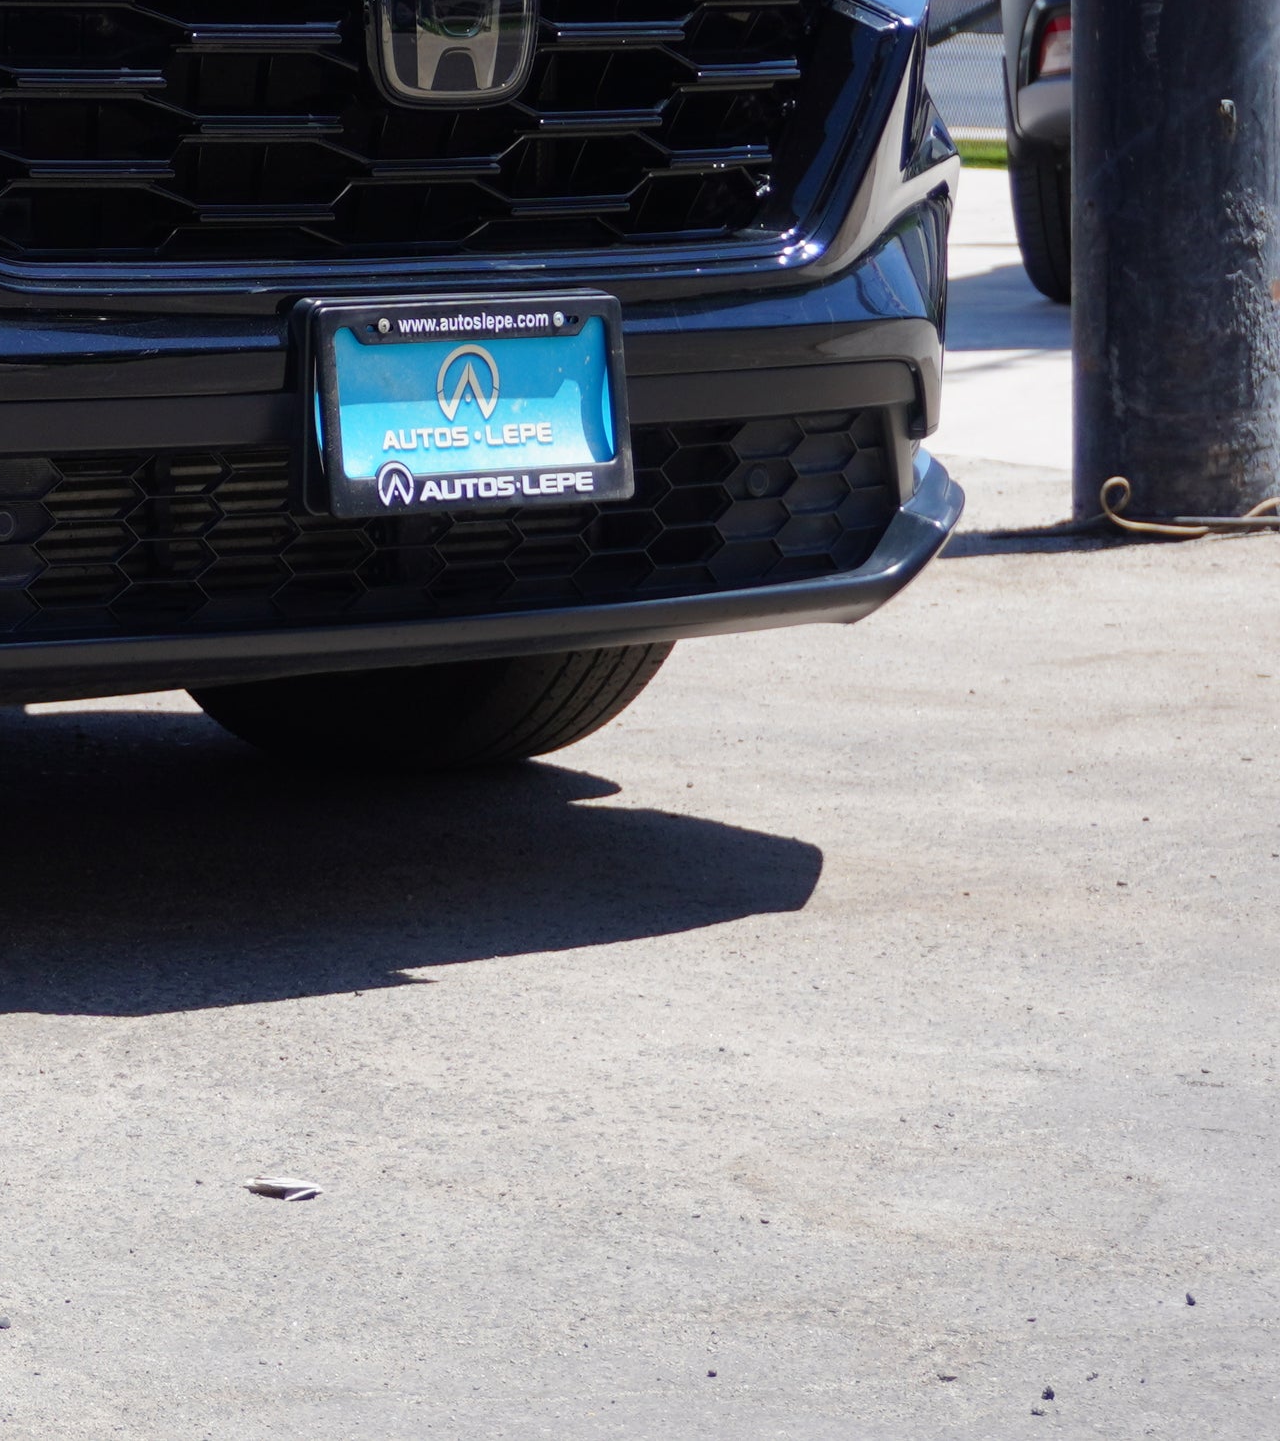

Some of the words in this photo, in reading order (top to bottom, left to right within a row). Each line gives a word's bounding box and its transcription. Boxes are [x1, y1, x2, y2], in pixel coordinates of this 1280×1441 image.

[397, 312, 549, 335] www.autoslepe.com
[383, 426, 469, 451] AUTOS
[486, 422, 553, 445] LEPE
